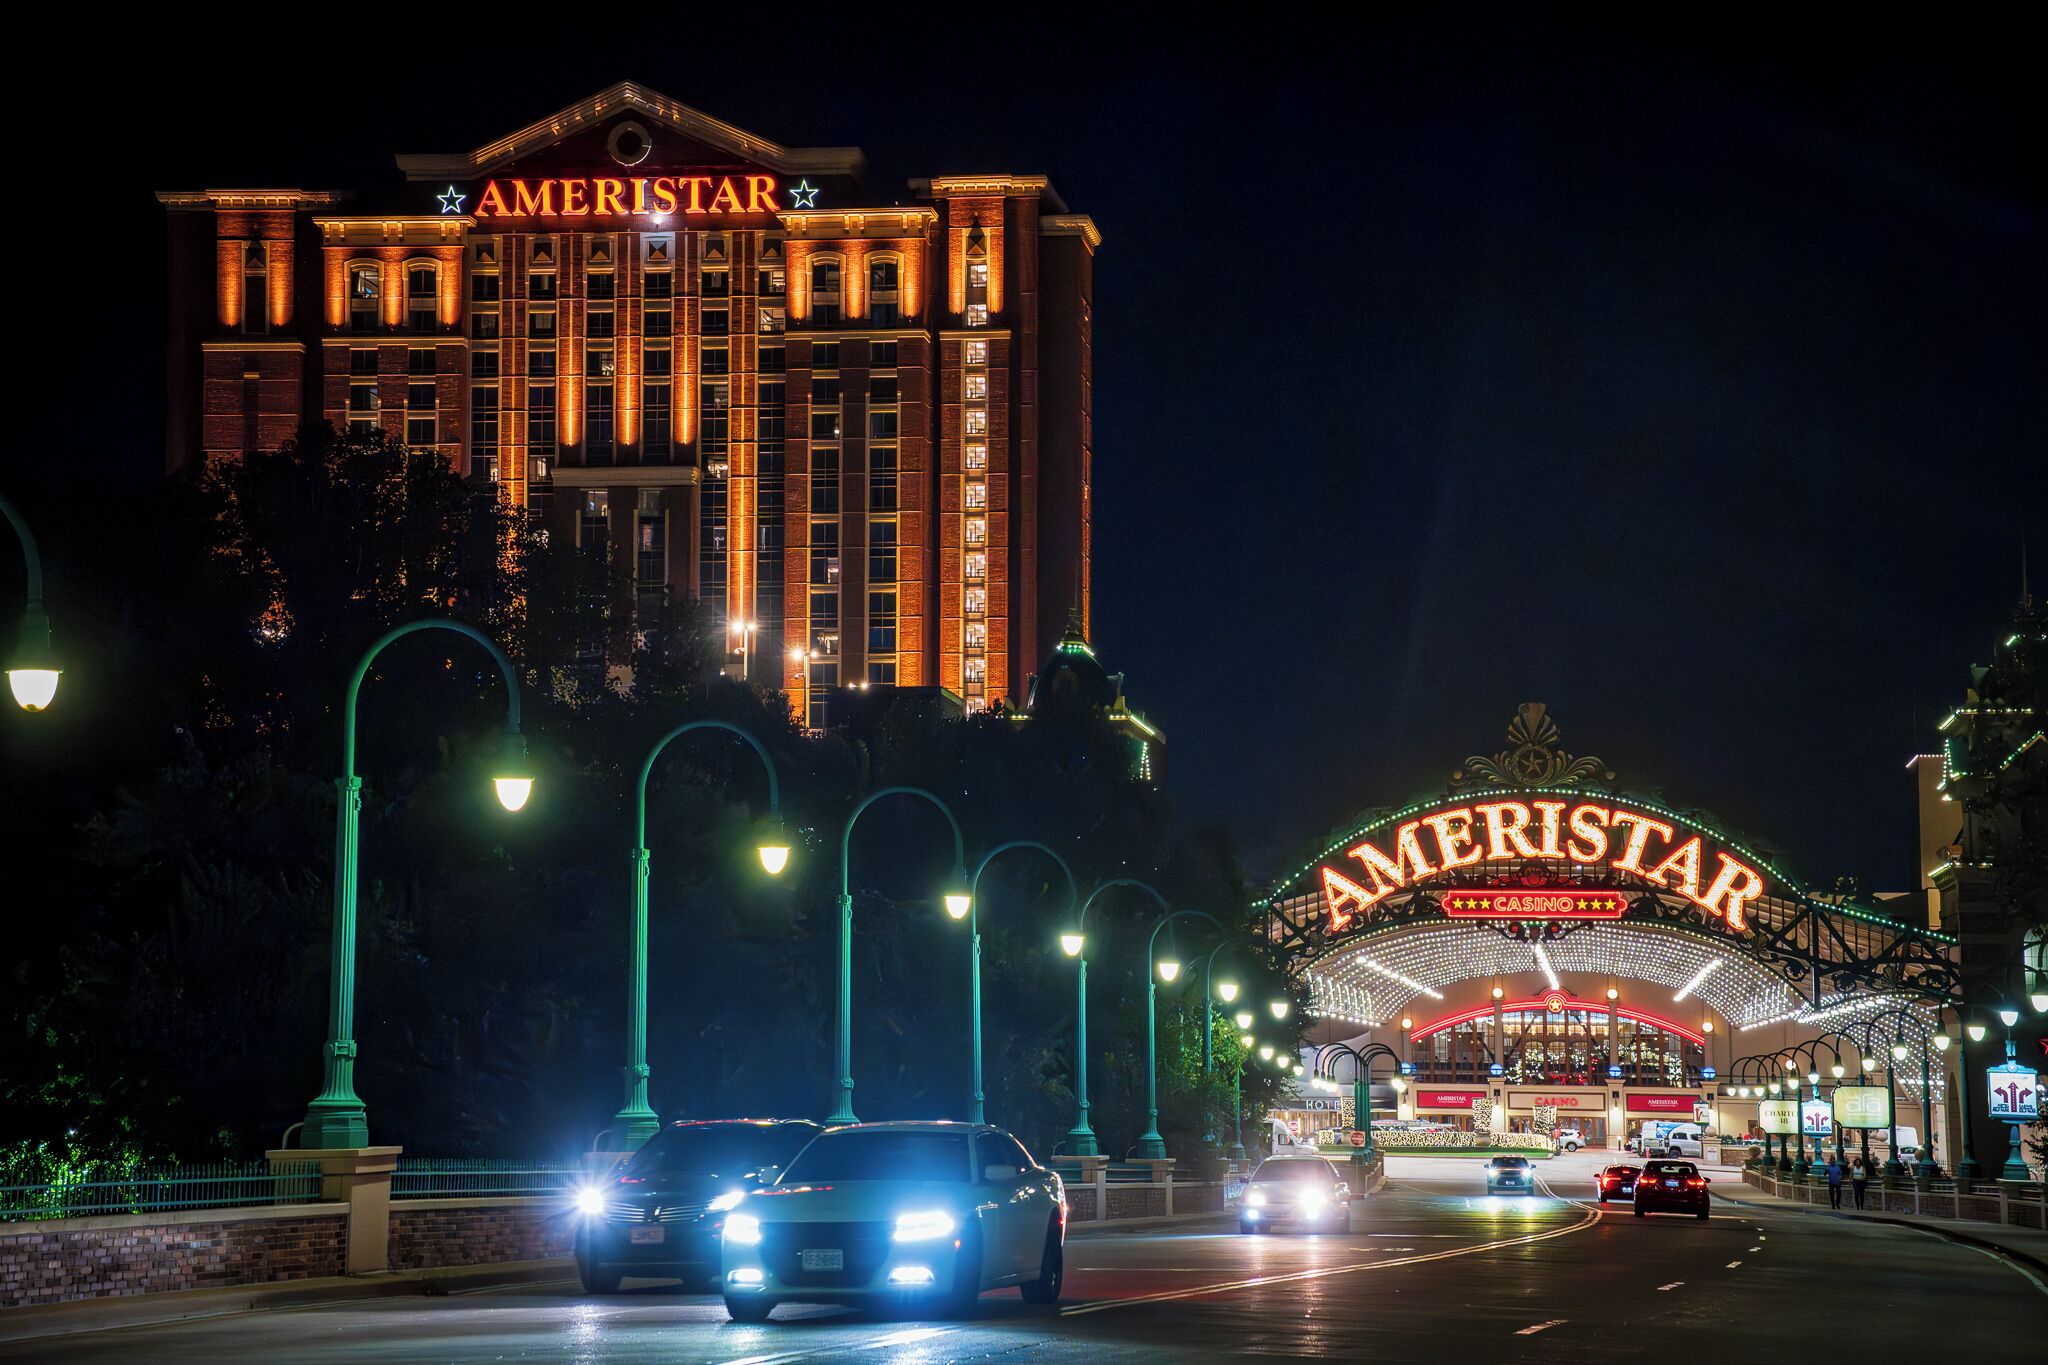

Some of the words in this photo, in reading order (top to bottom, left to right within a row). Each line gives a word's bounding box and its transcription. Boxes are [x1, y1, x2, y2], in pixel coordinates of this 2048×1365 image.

[473, 175, 782, 217] AMERISTAR
[1319, 799, 1764, 932] AMERISTAR
[1493, 896, 1574, 912] CASINO
[1306, 1100, 1341, 1110] HOTE
[1535, 1096, 1579, 1107] CASINO
